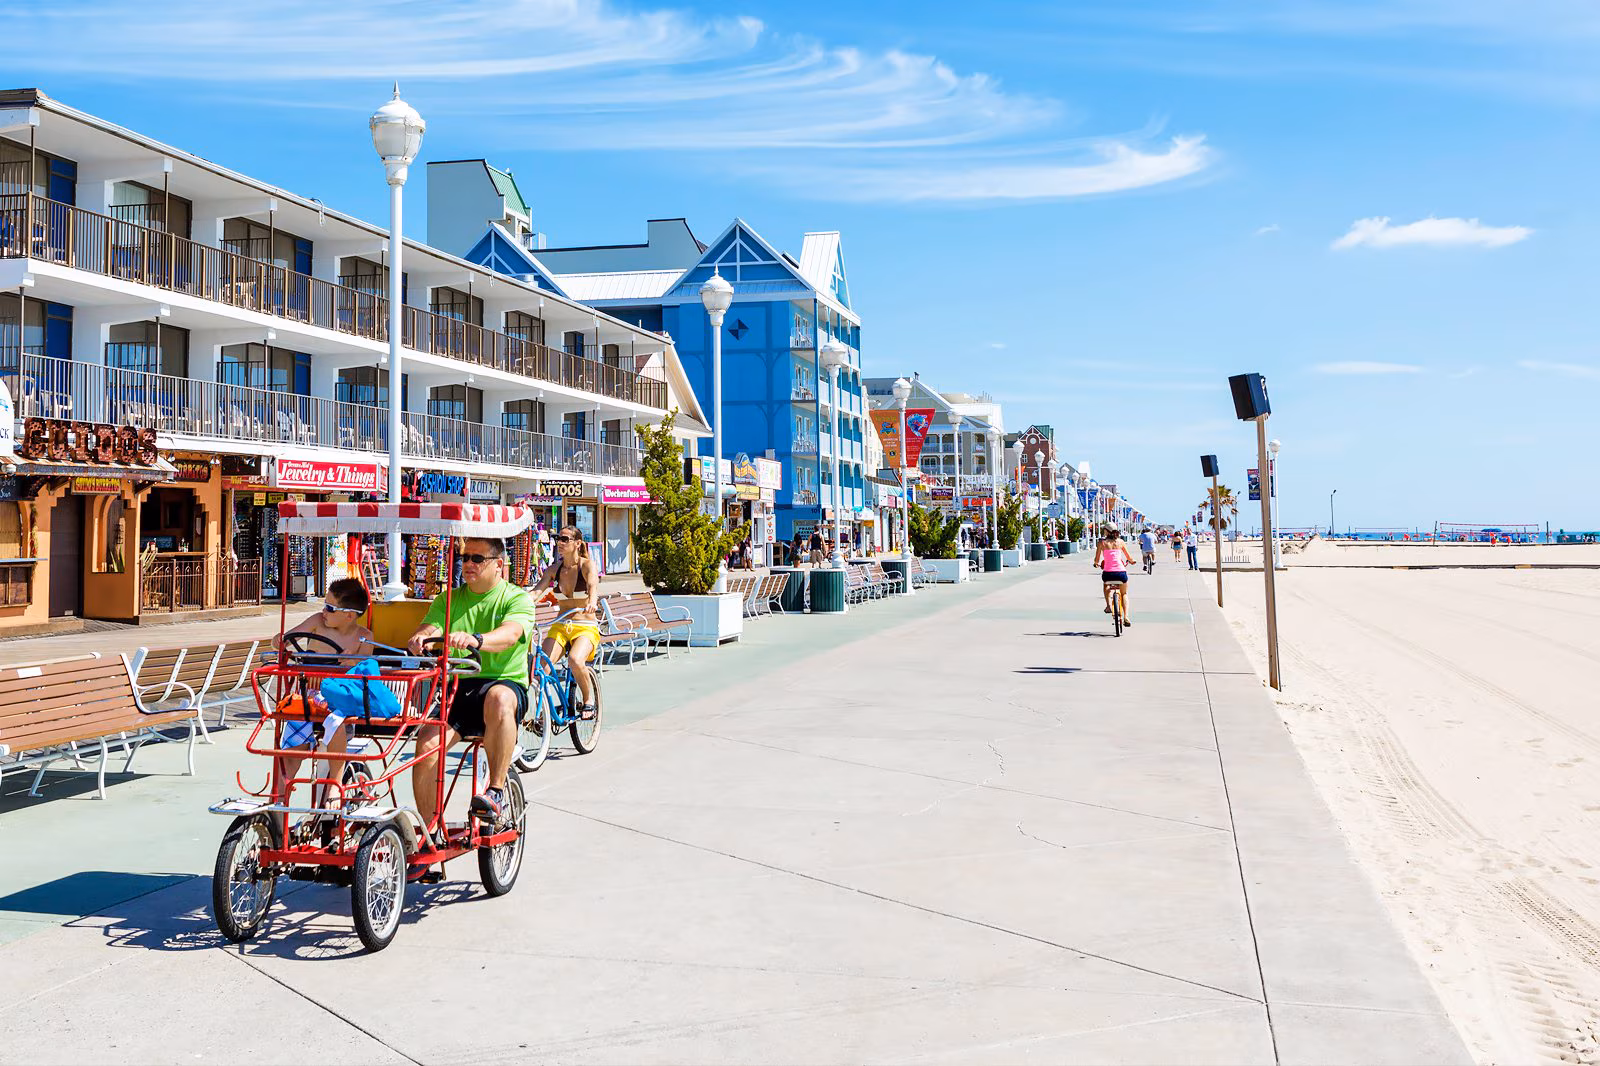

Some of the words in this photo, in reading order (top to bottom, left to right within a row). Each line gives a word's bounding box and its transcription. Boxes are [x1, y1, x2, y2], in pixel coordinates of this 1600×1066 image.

[0, 428, 9, 439] CK
[23, 417, 158, 464] GUIDOS
[278, 463, 326, 486] Jewelry
[327, 468, 335, 481] &
[336, 465, 375, 488] Things
[420, 473, 447, 494] FASHION
[447, 475, 465, 494] SHOP
[477, 481, 488, 493] CITY
[489, 482, 493, 494] 2
[540, 484, 582, 496] ATTOOS
